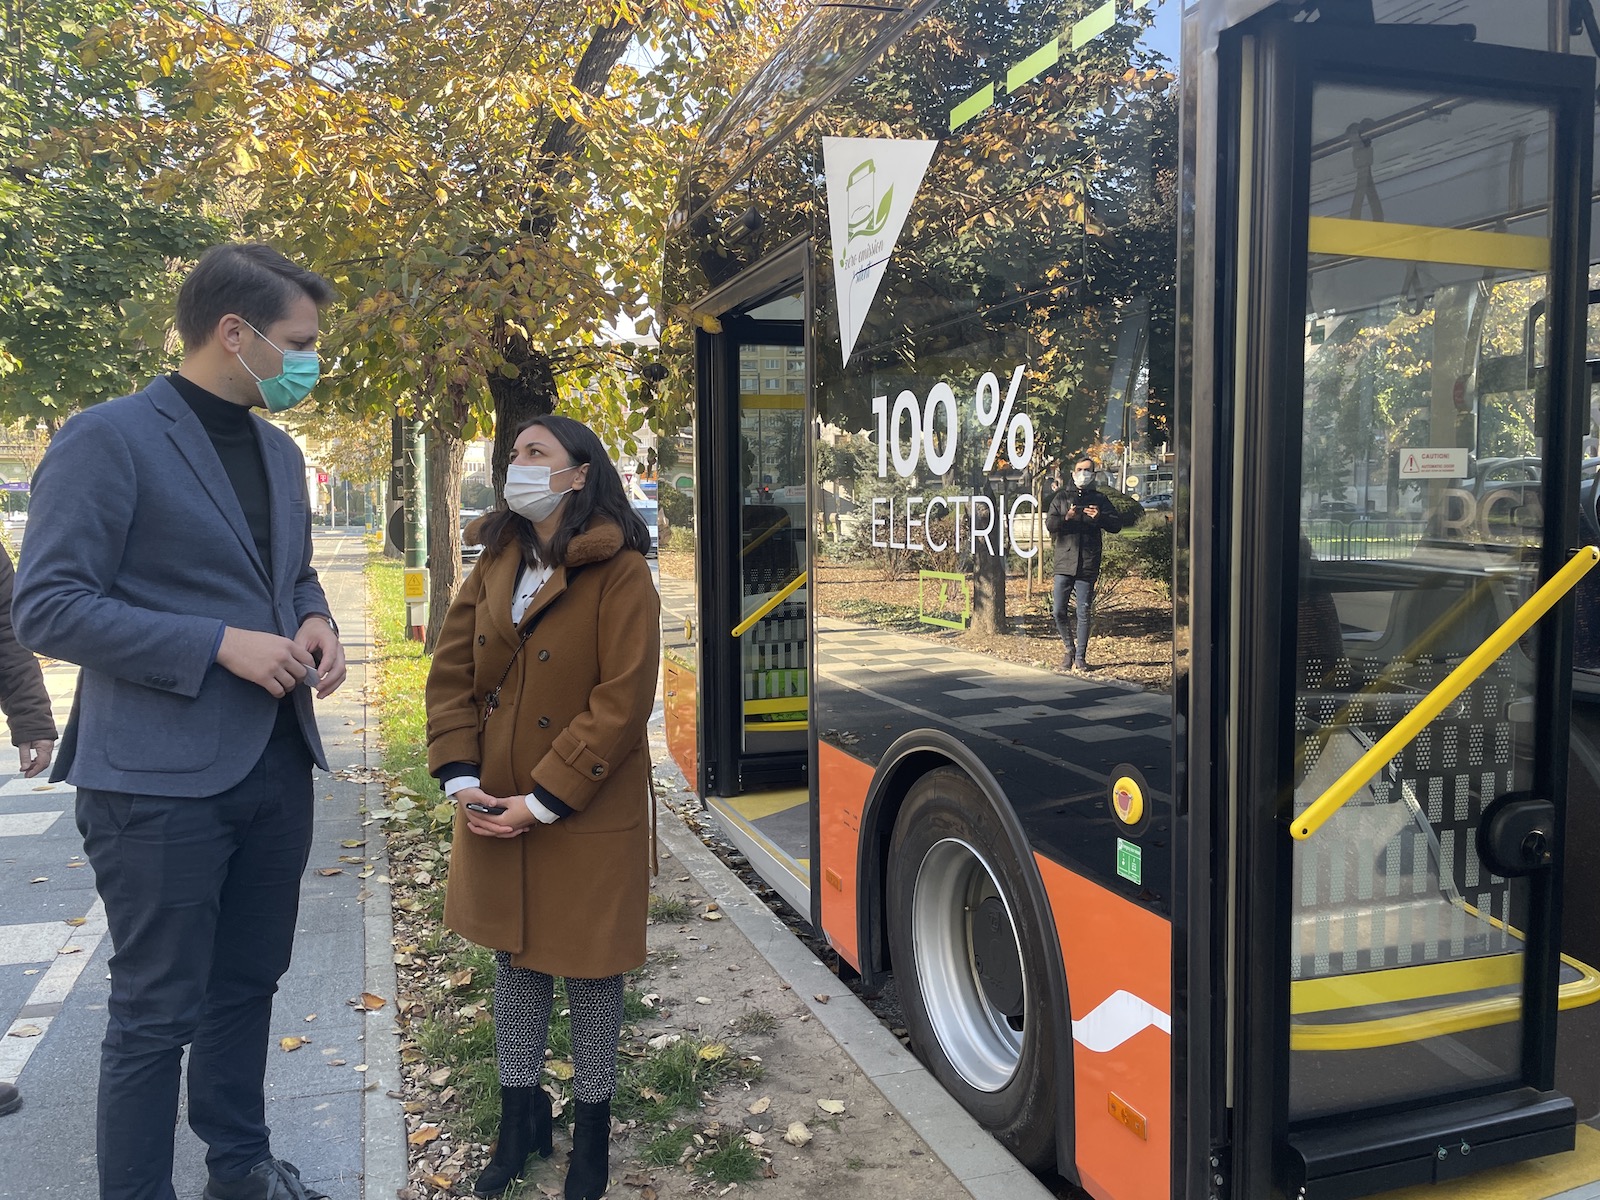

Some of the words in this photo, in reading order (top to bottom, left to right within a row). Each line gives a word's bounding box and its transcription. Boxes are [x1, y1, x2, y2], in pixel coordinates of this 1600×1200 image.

[872, 382, 958, 478] 100
[975, 364, 1034, 473] %
[872, 493, 1039, 559] ELECTRIC
